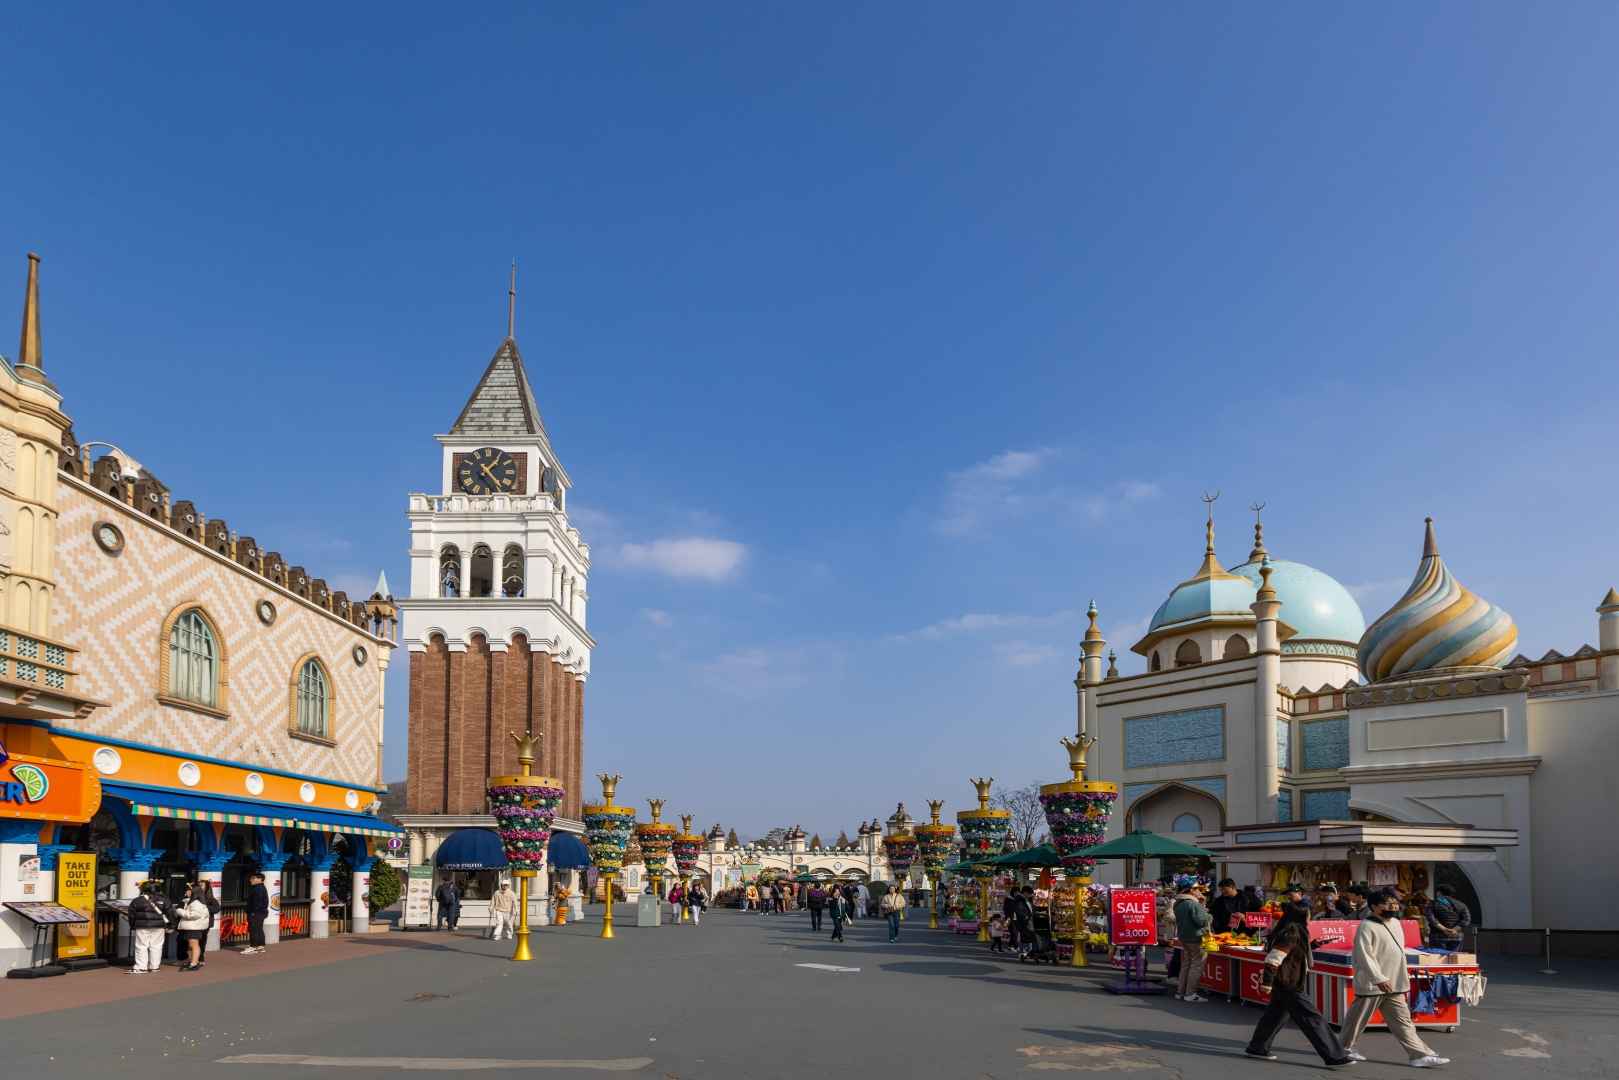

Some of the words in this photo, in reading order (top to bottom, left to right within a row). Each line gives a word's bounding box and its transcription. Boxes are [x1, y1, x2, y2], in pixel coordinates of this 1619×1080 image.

[65, 862, 91, 870] TAKE
[65, 880, 90, 888] ONLY
[1117, 902, 1150, 914] SALE
